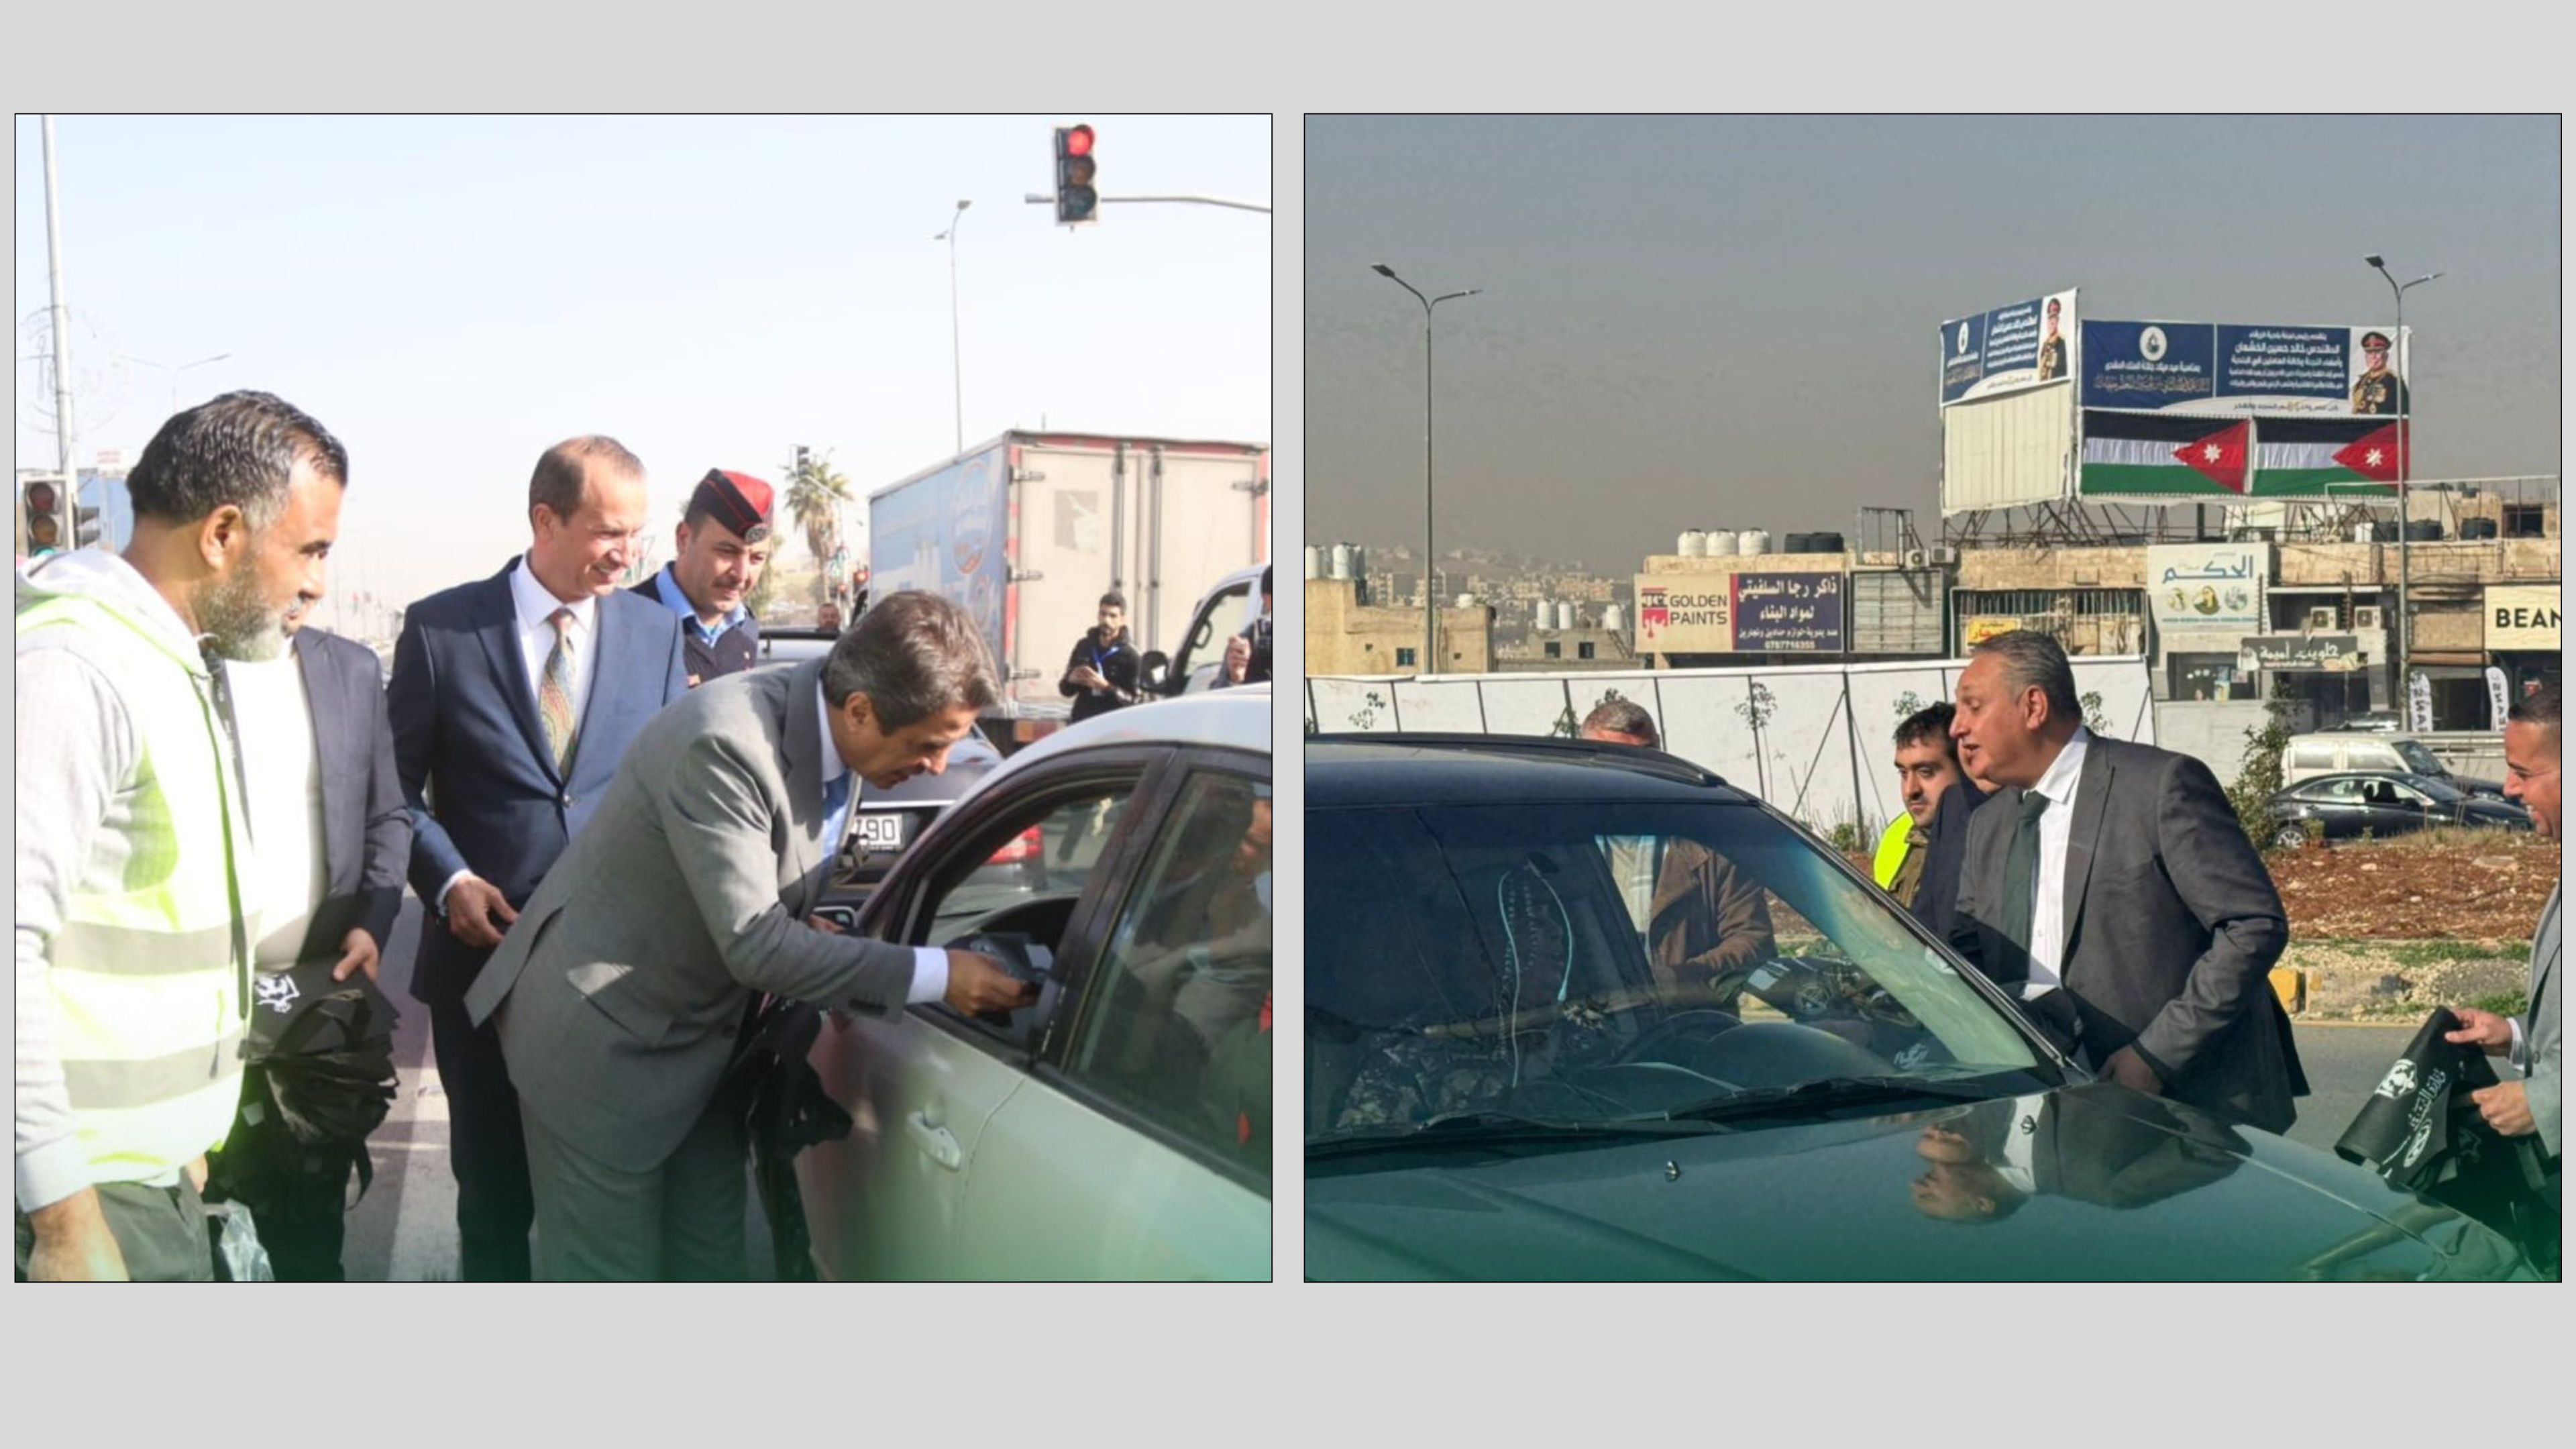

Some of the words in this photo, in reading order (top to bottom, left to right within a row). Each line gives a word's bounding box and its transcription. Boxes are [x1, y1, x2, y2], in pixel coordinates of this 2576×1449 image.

[2162, 555, 2253, 584] الحكم
[1788, 579, 1810, 598] رجا
[1814, 576, 1837, 598] ذاكر
[1670, 594, 1727, 608] GOLDEN
[1670, 611, 1727, 625] PAINTS
[1760, 605, 1787, 623] البناء
[1789, 605, 1815, 623] لمواد
